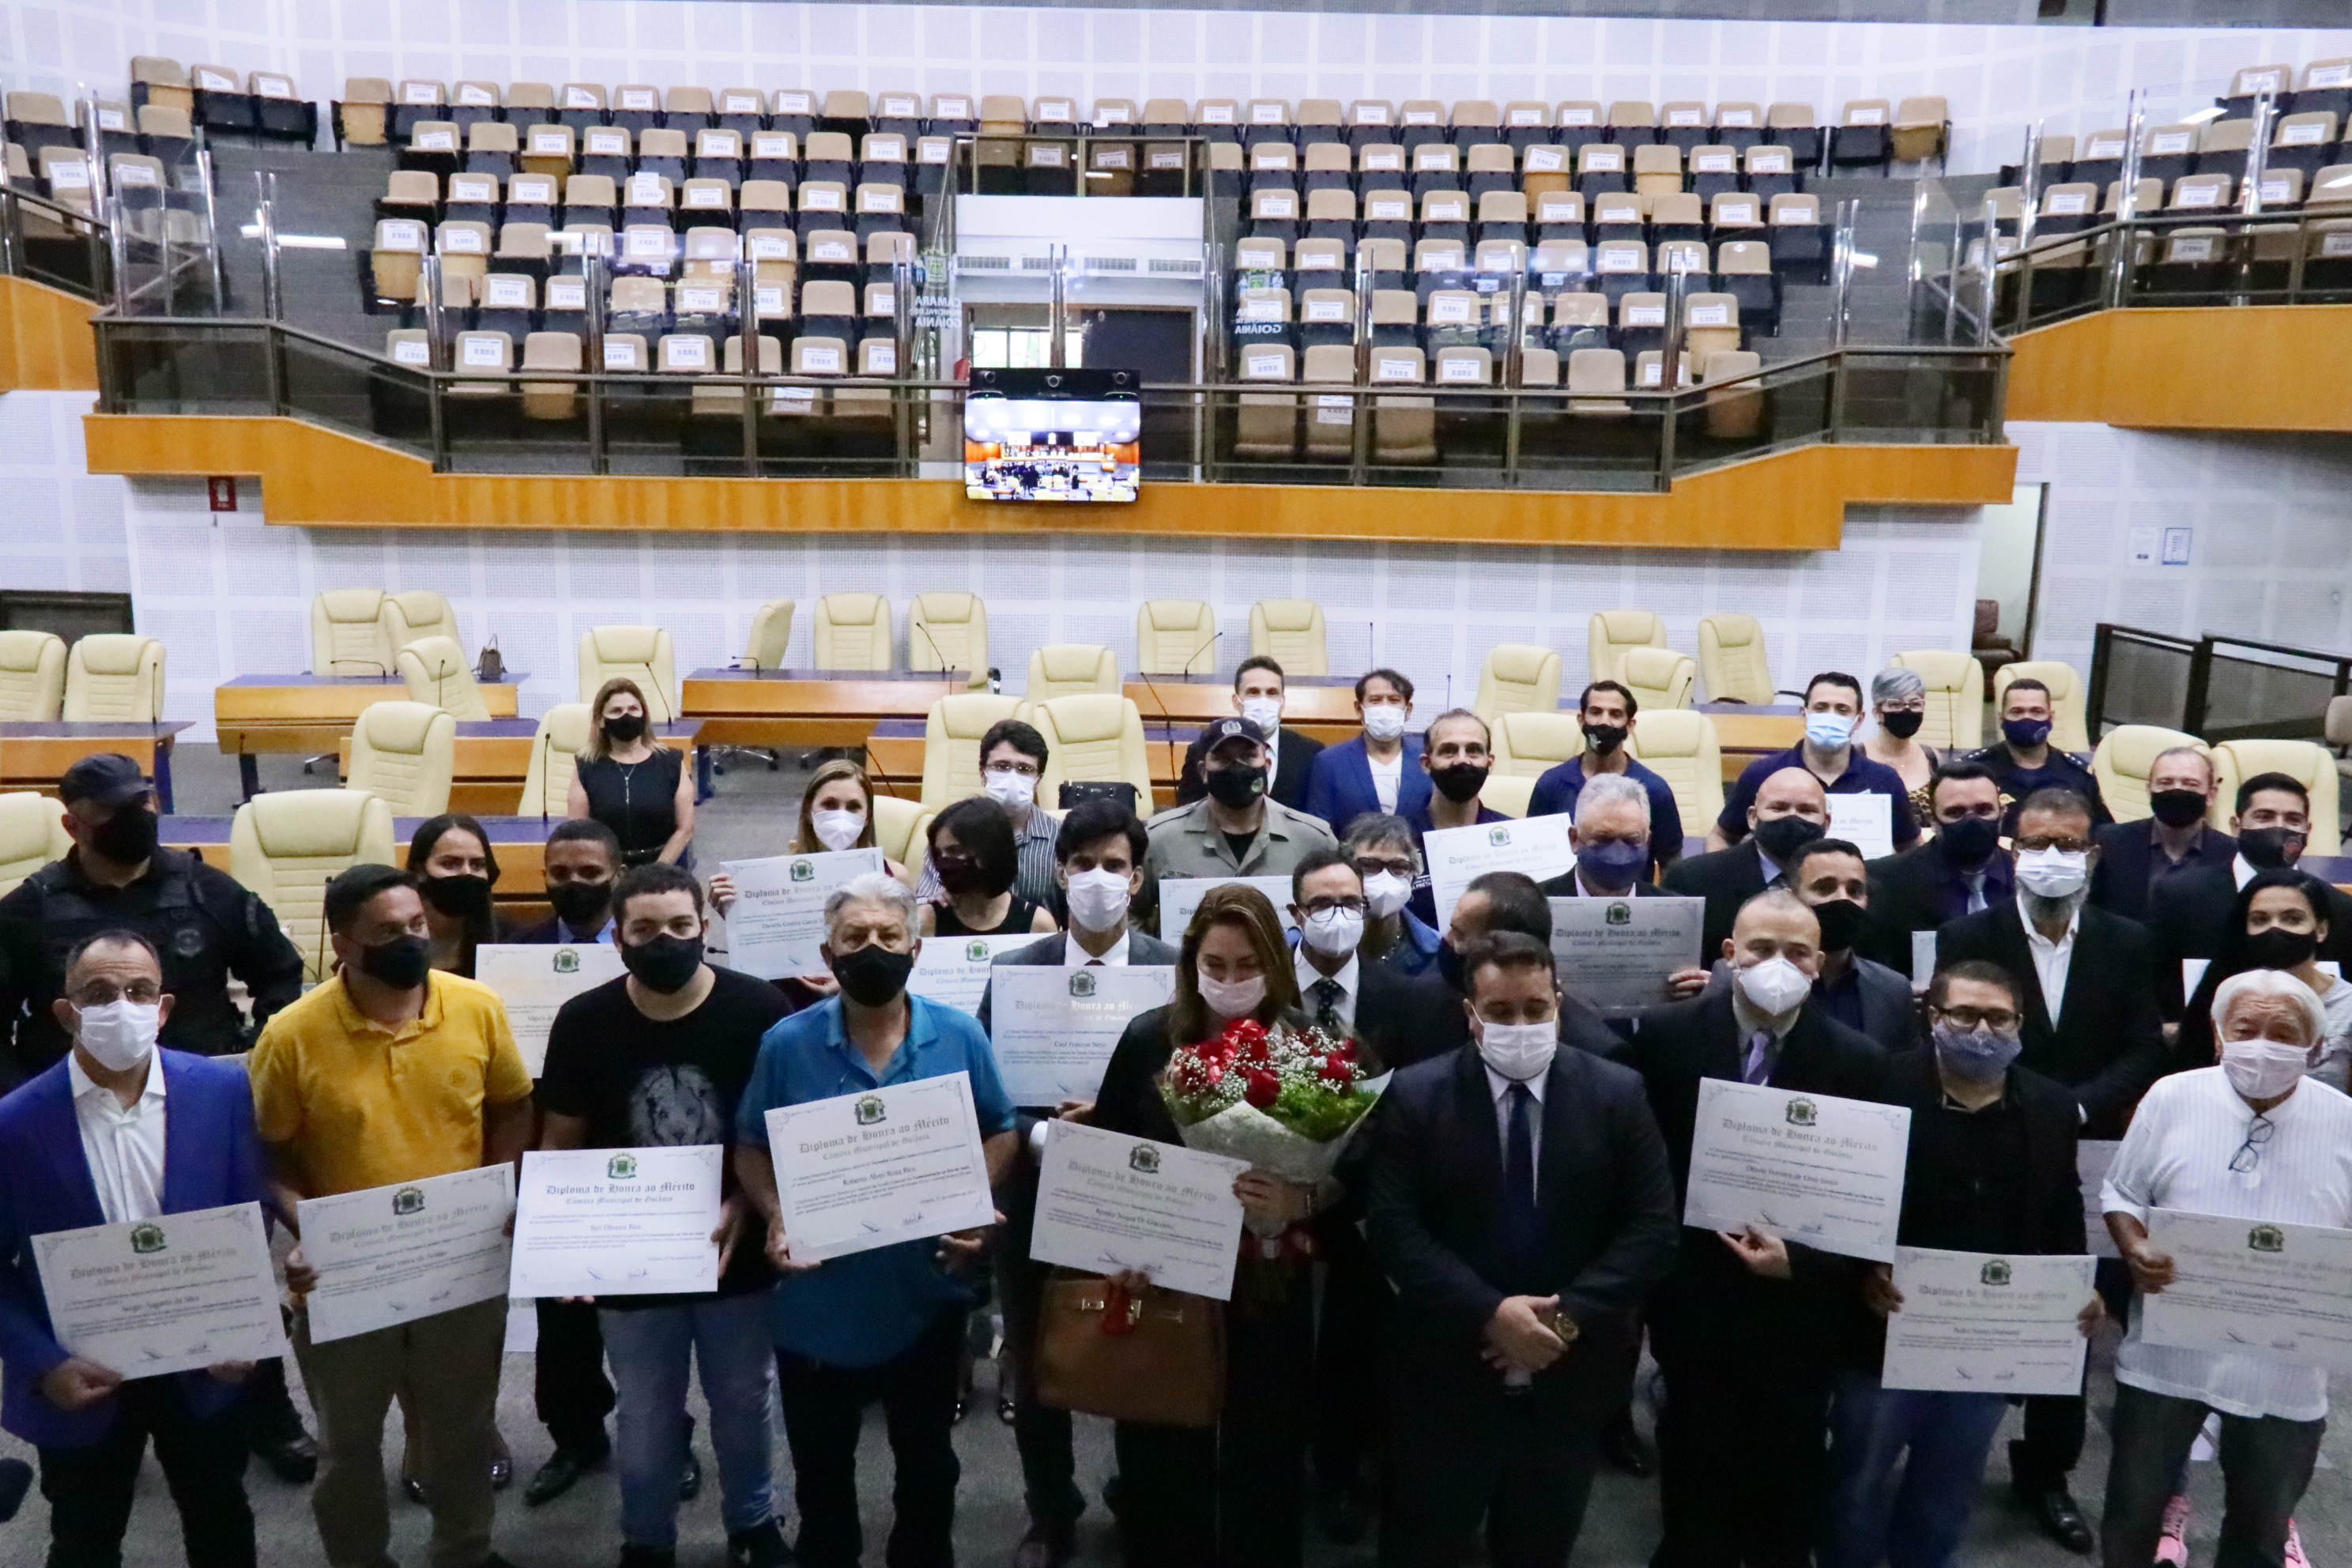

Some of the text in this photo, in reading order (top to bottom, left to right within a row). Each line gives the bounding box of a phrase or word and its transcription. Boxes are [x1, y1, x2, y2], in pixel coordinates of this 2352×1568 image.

[1449, 854, 1481, 865] Diploma
[744, 890, 779, 899] Diploma
[793, 885, 821, 895] Honra
[1555, 929, 1592, 937] Diploma
[1608, 928, 1634, 937] Honra
[919, 968, 954, 977] Diploma
[969, 965, 990, 974] Honr
[1071, 1000, 1101, 1011] Honra
[798, 1115, 950, 1154] Diploma de Honra ao Mérito
[1722, 1118, 1879, 1152] Diploma de Honra ao Mérito
[822, 1149, 851, 1160] Câmara
[854, 1141, 890, 1155] Municipal
[842, 1175, 867, 1186] Roberto
[869, 1172, 885, 1182] Alves
[1068, 1160, 1218, 1203] Diploma de Honra ao Mérito
[546, 1181, 695, 1196] Diploma de Honra ao Mérito
[566, 1196, 594, 1205] Câmara
[597, 1196, 632, 1205] Municipal
[644, 1195, 673, 1204] Goiânia
[330, 1227, 378, 1243] Diploma
[381, 1223, 393, 1234] de
[398, 1217, 432, 1230] Honra
[452, 1203, 488, 1219] Mérito
[1118, 1212, 1136, 1222] Souza
[70, 1262, 120, 1280] Diploma
